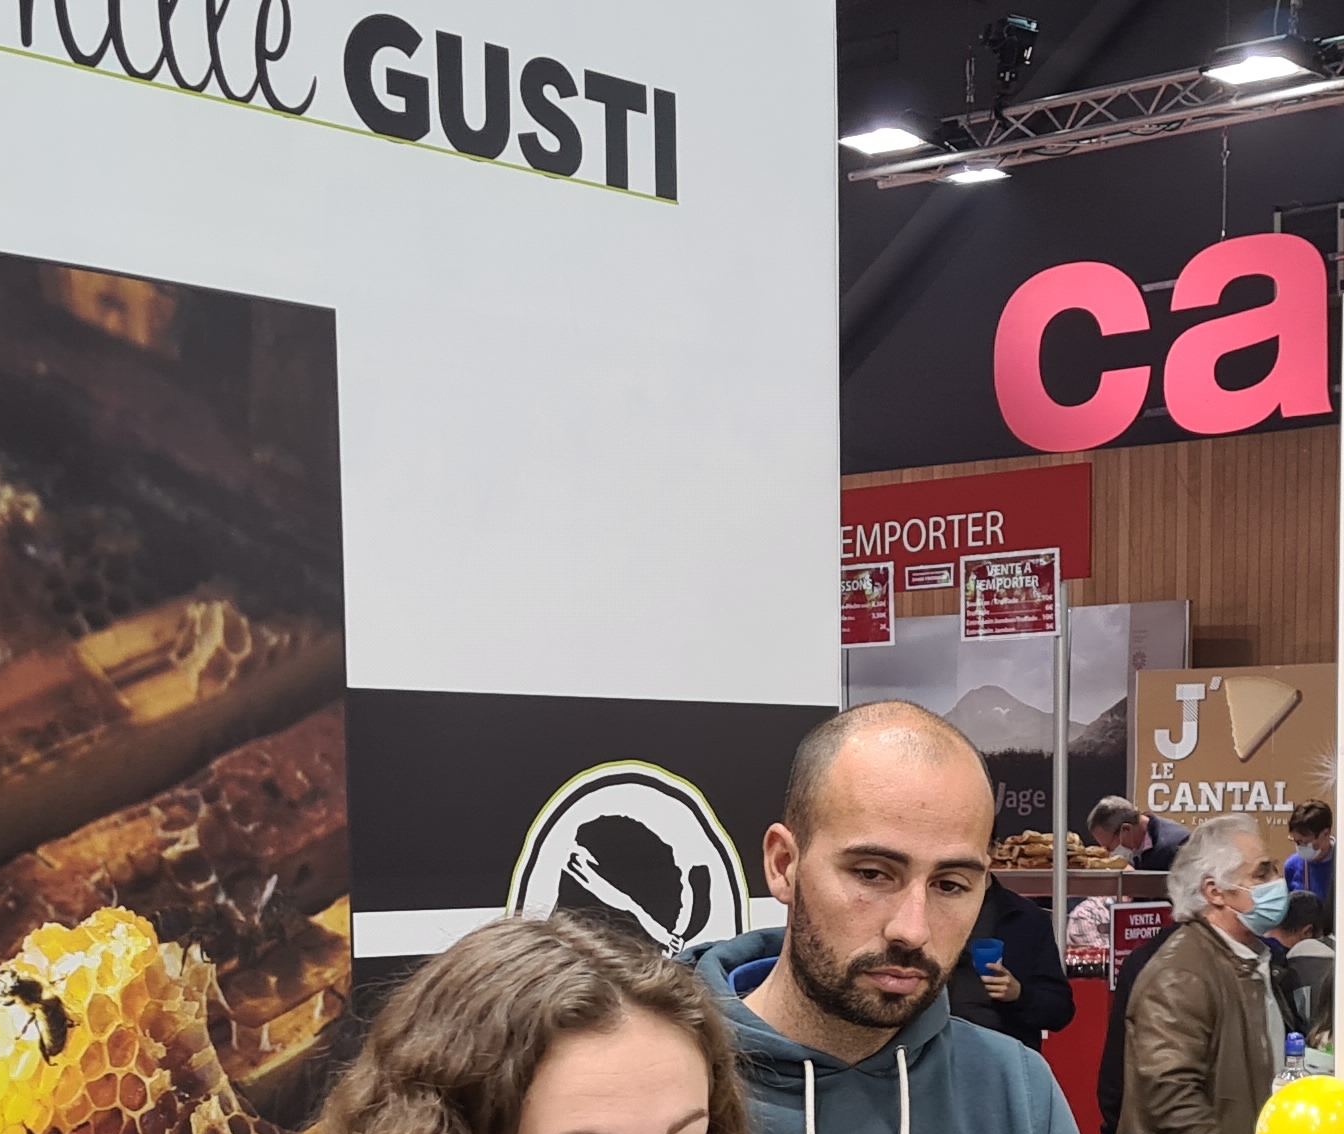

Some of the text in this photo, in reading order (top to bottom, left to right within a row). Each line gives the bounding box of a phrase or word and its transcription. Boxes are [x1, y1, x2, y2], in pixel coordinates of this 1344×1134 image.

[343, 13, 678, 200] GUSTI
[841, 511, 1004, 558] EMPORTER
[986, 563, 1022, 576] VENTE
[840, 579, 872, 592] SSONS
[978, 575, 1039, 591] EMPORTER
[1151, 763, 1174, 779] LE
[1148, 782, 1294, 812] CANTAL
[1266, 815, 1289, 826] Vieu
[1129, 913, 1154, 926] VENTE
